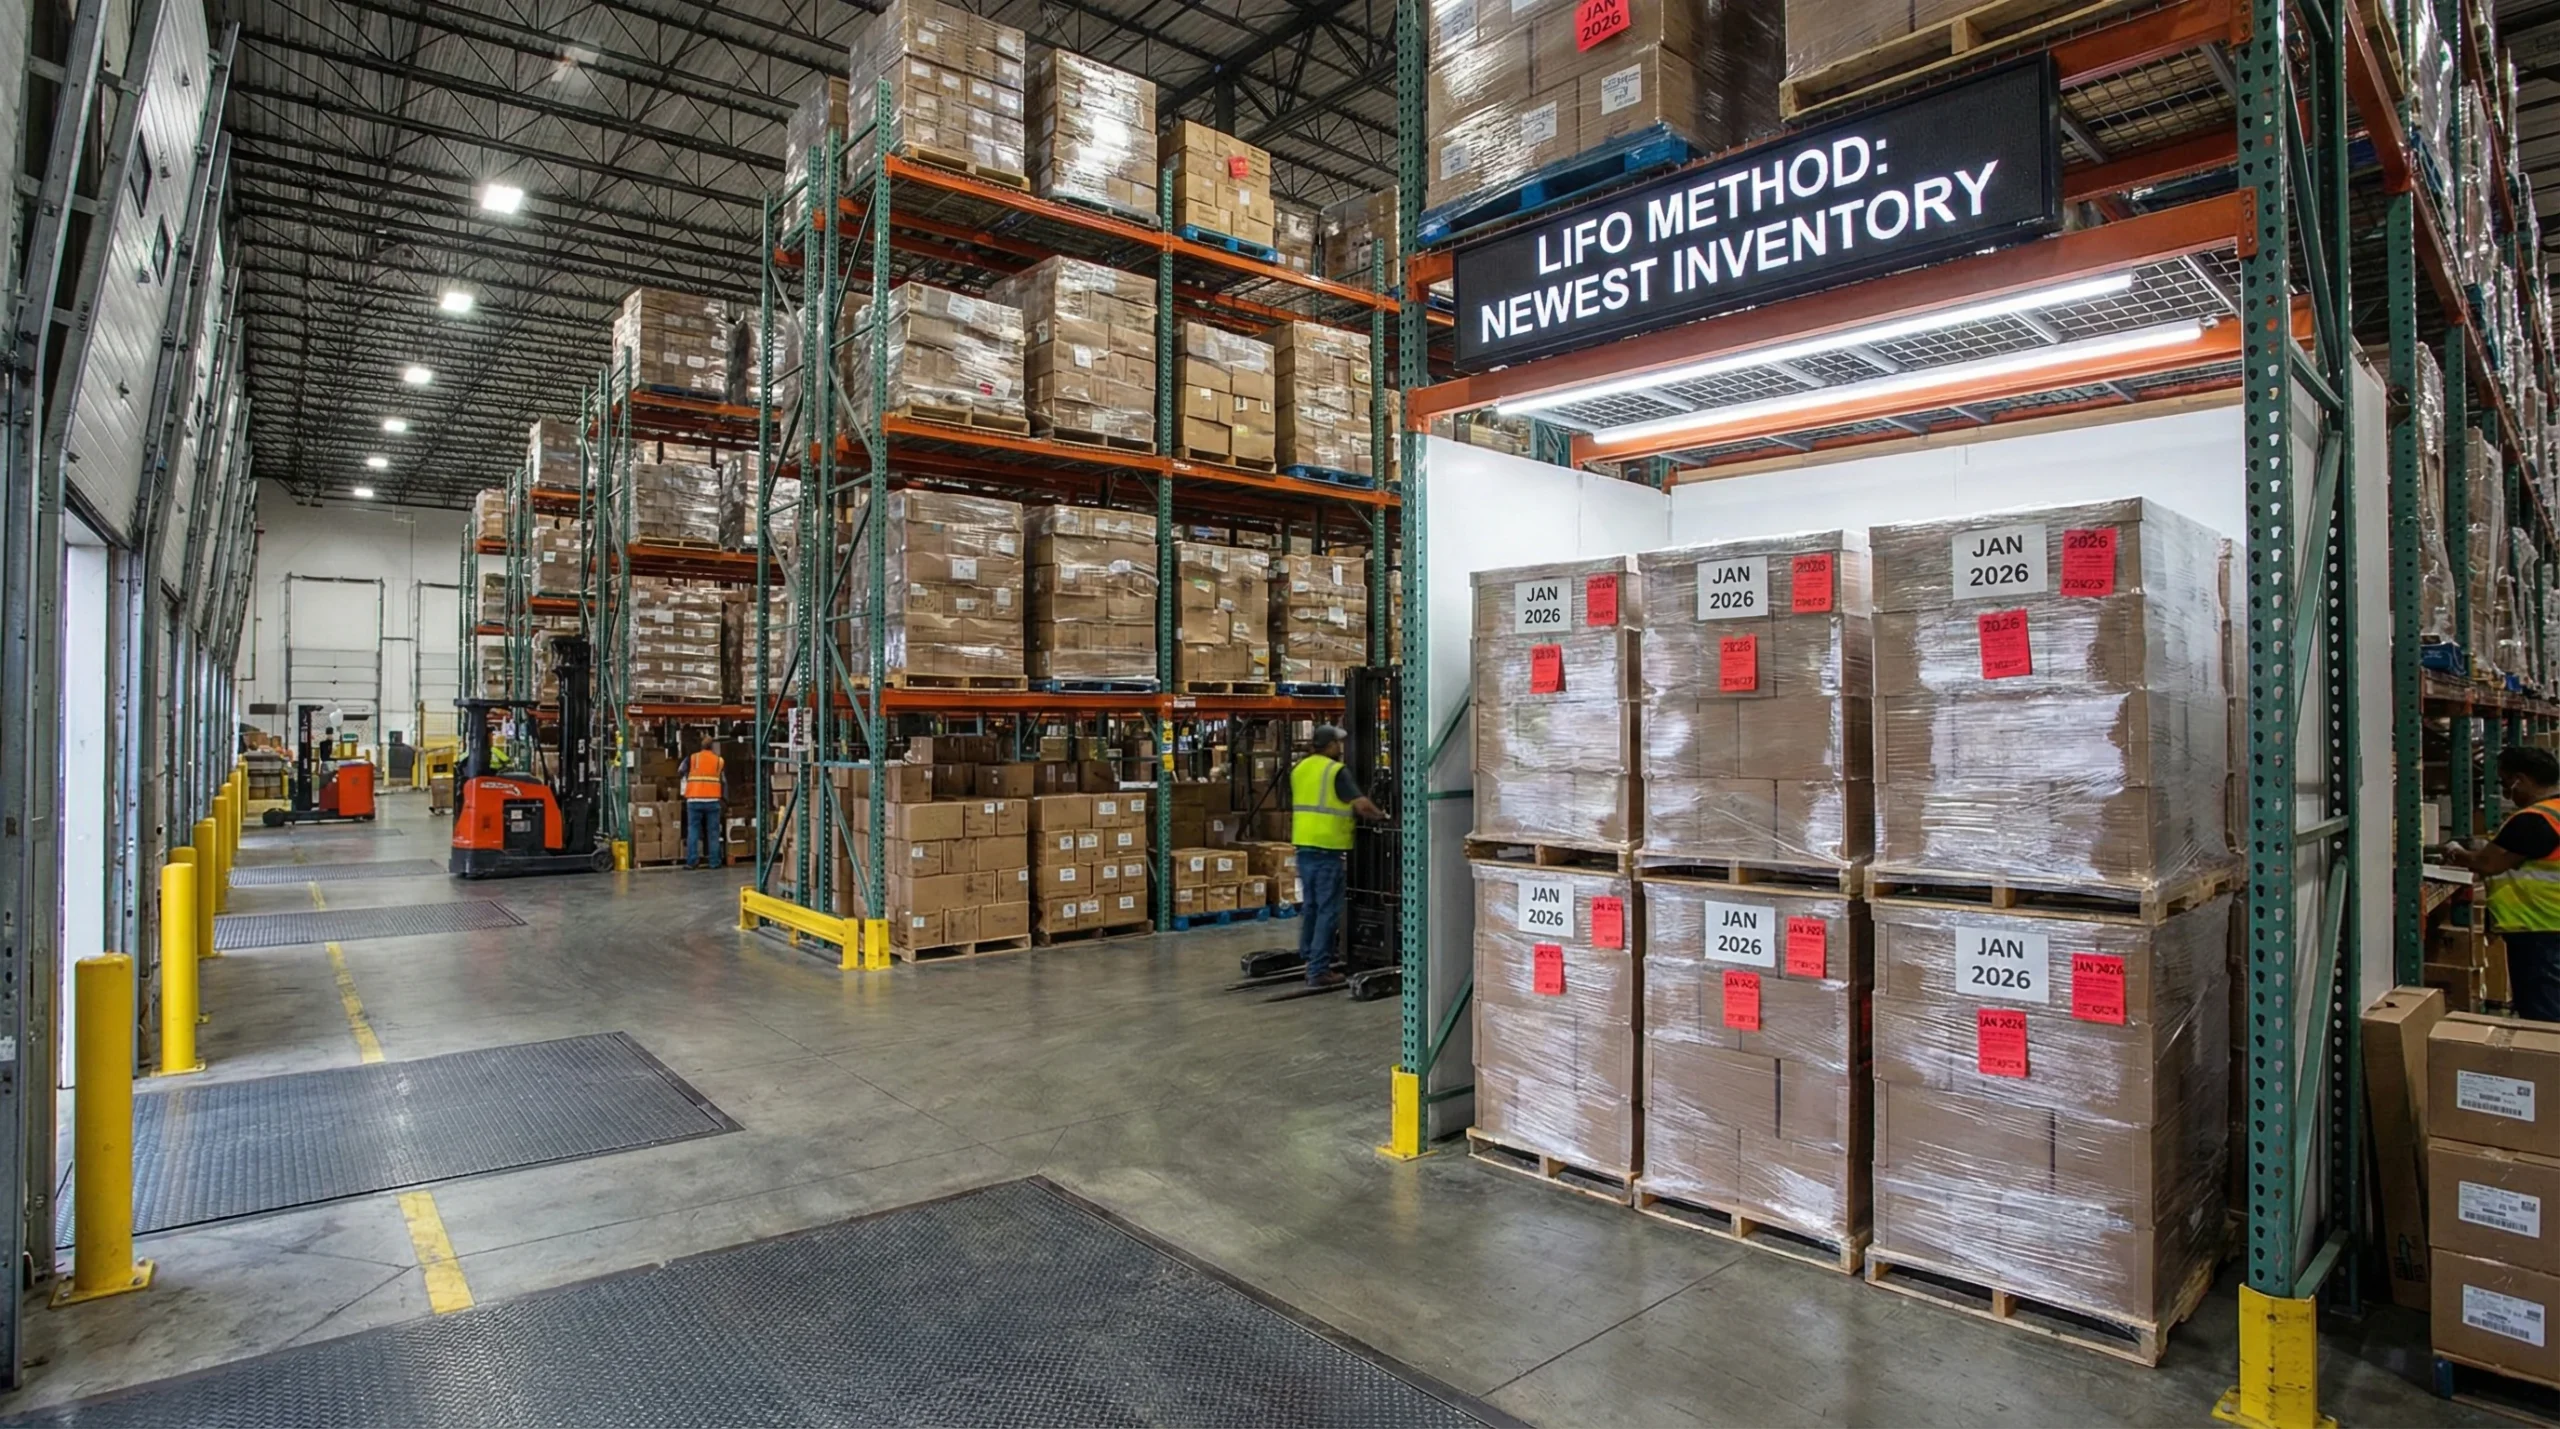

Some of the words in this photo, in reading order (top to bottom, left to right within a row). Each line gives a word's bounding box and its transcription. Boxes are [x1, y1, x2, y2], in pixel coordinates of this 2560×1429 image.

[1585, 0, 1616, 22] JAN
[1582, 10, 1621, 42] 2026
[1538, 211, 1633, 276] LIFO
[1647, 136, 1888, 243] METHOD:
[1481, 256, 1658, 344] NEWEST
[1673, 159, 1999, 294] INVENTORY
[1972, 534, 2023, 558] JAN
[2068, 535, 2108, 549] 2026
[1712, 565, 1750, 585] JAN
[1969, 562, 2029, 587] 2026
[1526, 586, 1558, 603] JAN
[1710, 590, 1754, 610] 2026
[1524, 607, 1561, 624] 2026
[1983, 616, 2020, 633] 2026
[1532, 887, 1560, 903] JAN
[1528, 908, 1564, 926] 2026
[1722, 910, 1757, 929] JAN
[1718, 935, 1762, 955] 2026
[1977, 937, 2024, 959] JAN
[2074, 960, 2094, 973] JAN
[1972, 965, 2031, 990] 2026
